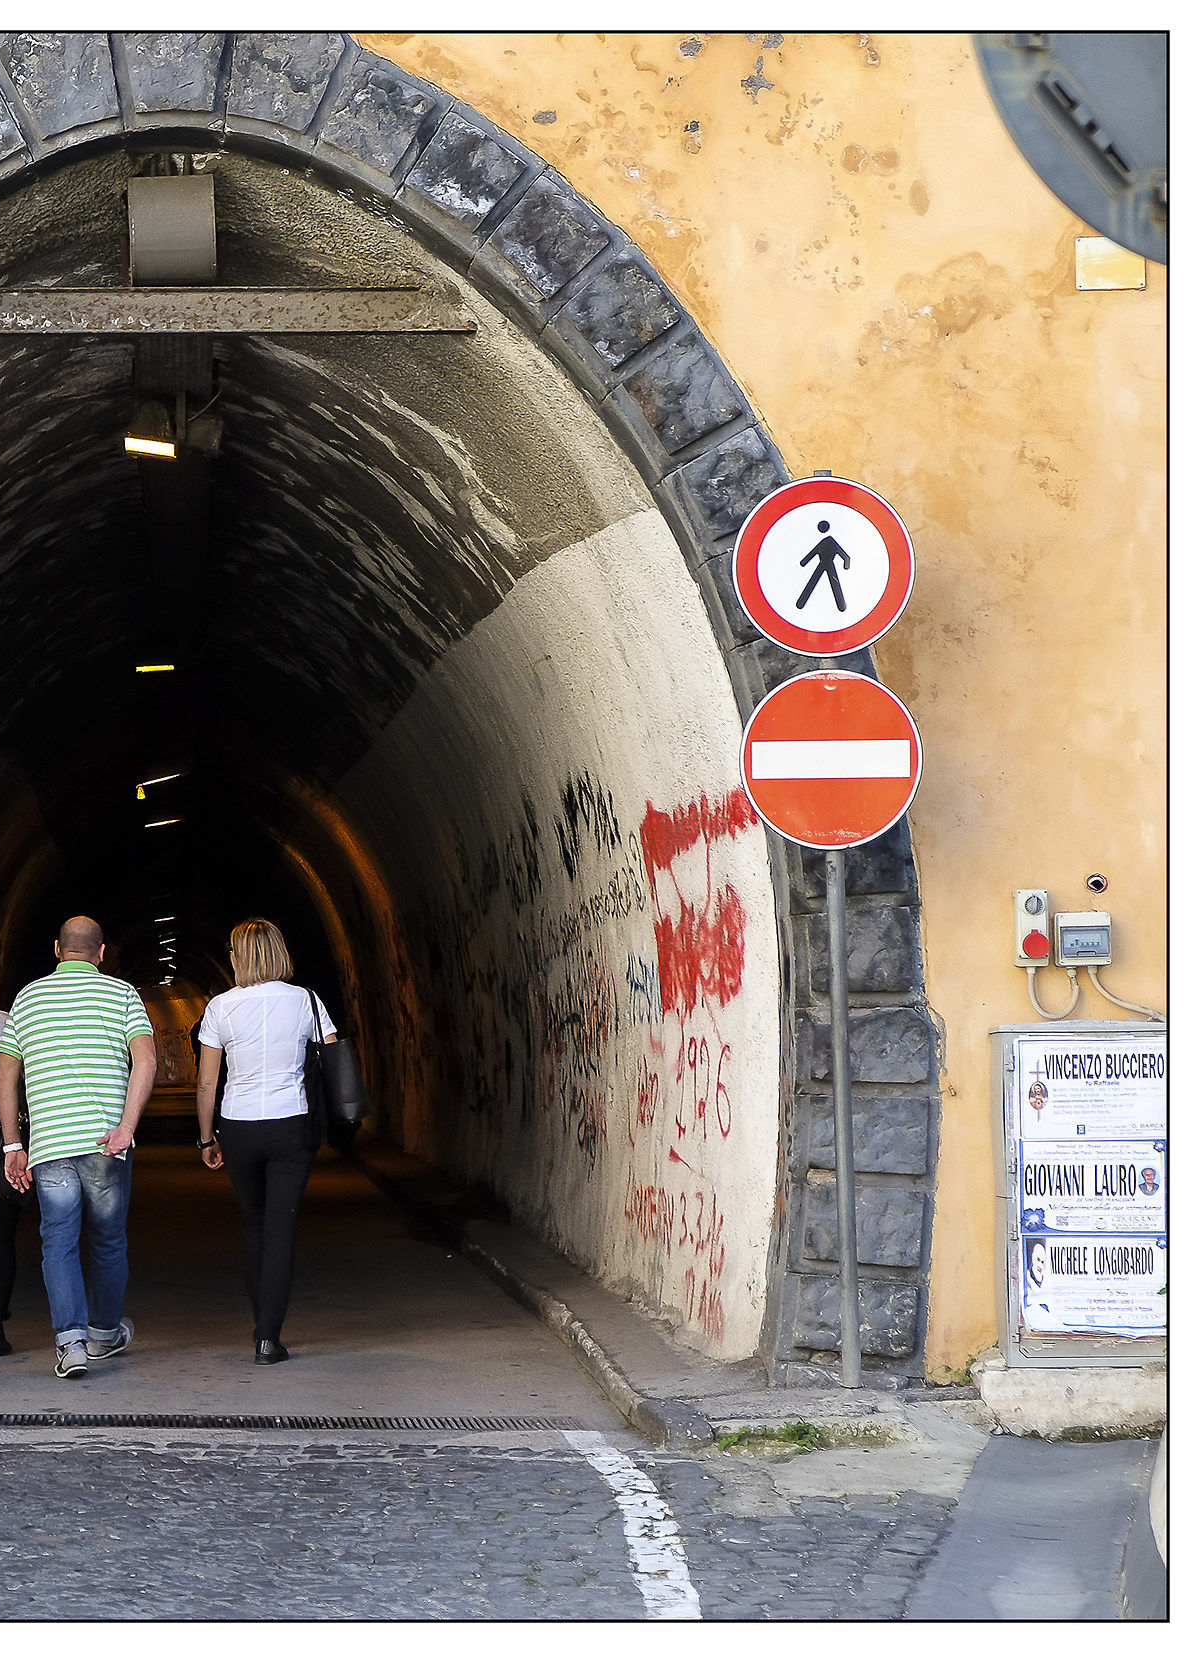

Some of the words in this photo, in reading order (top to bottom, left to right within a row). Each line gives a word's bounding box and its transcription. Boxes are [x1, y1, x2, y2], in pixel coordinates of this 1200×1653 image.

[1044, 1053, 1102, 1080] VINCENZO
[1105, 1052, 1165, 1079] BUCCIERO
[1024, 1163, 1085, 1197] GIOVANNI
[1094, 1163, 1137, 1197] LAURO
[1049, 1246, 1088, 1275] MICHELE
[1093, 1246, 1154, 1275] LONGOBARDO
